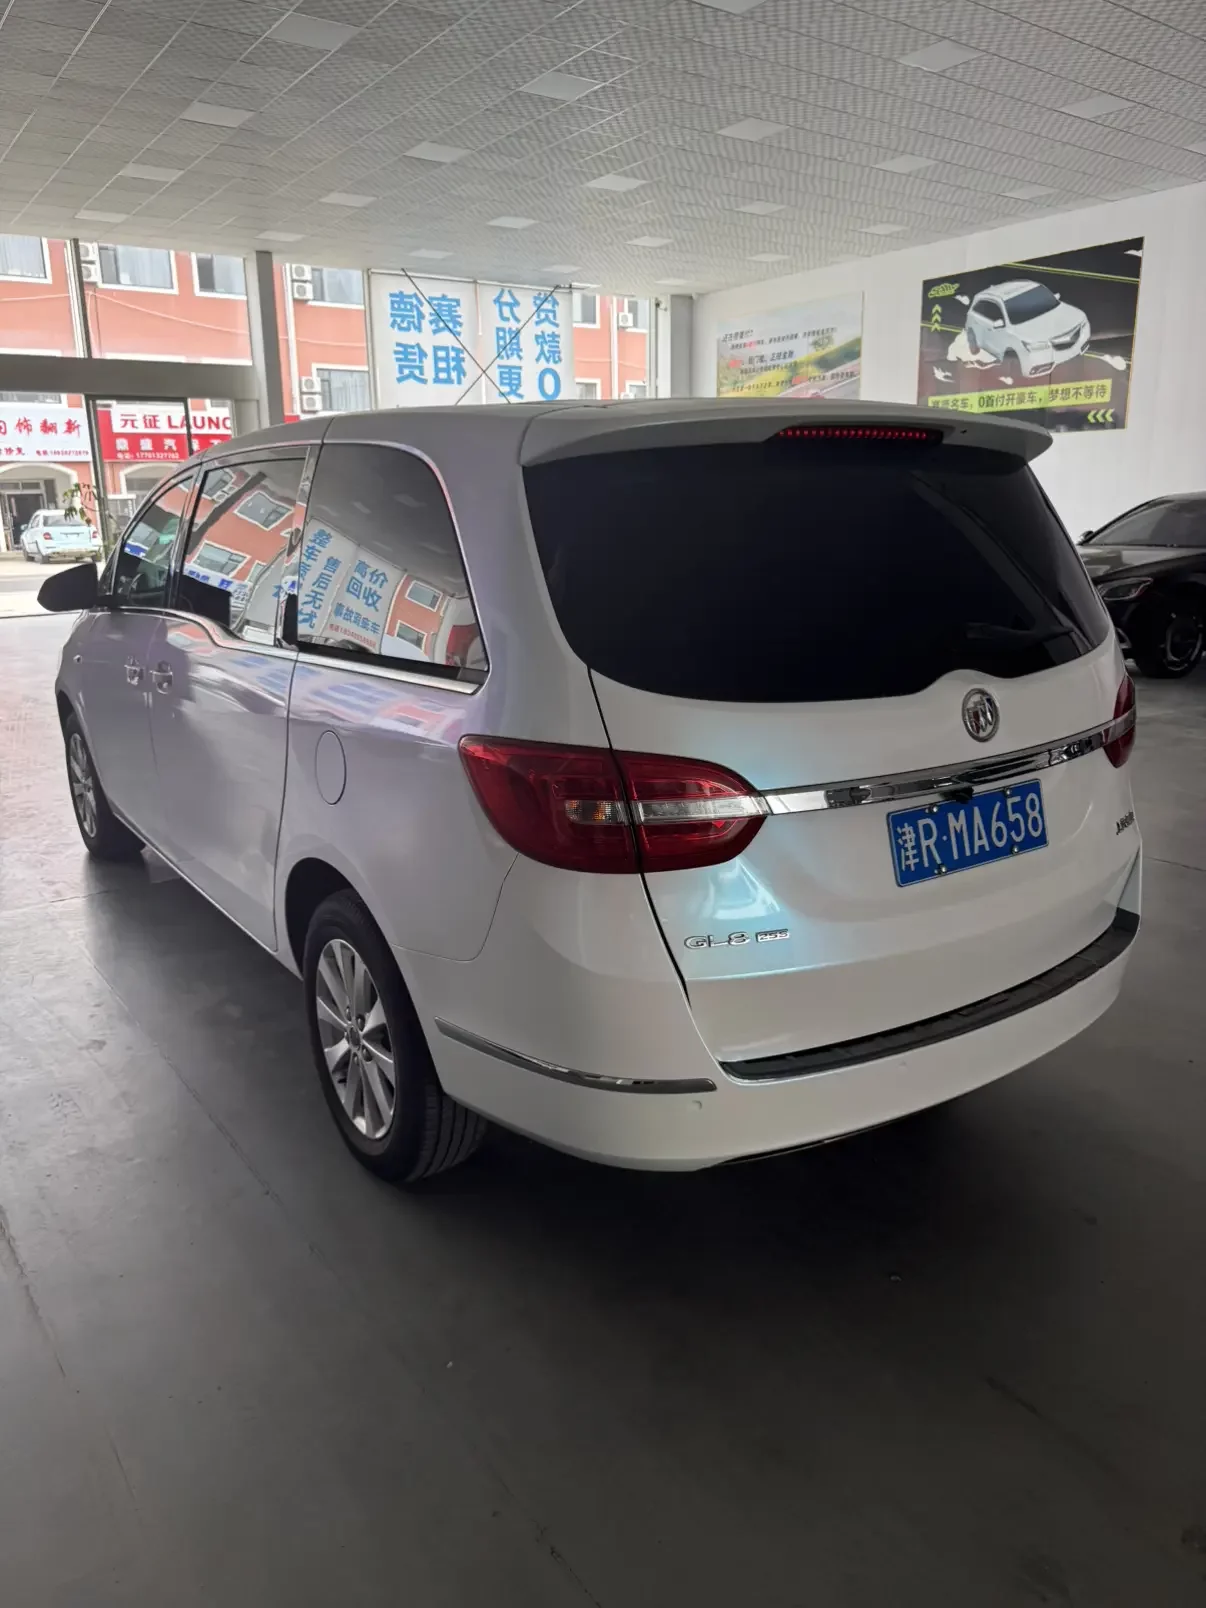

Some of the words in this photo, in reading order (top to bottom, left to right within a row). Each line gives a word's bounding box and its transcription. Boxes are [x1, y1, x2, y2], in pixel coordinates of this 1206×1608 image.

[121, 413, 160, 429] 元征
[896, 792, 1043, 872] 津R·MA658
[684, 931, 750, 949] GL8
